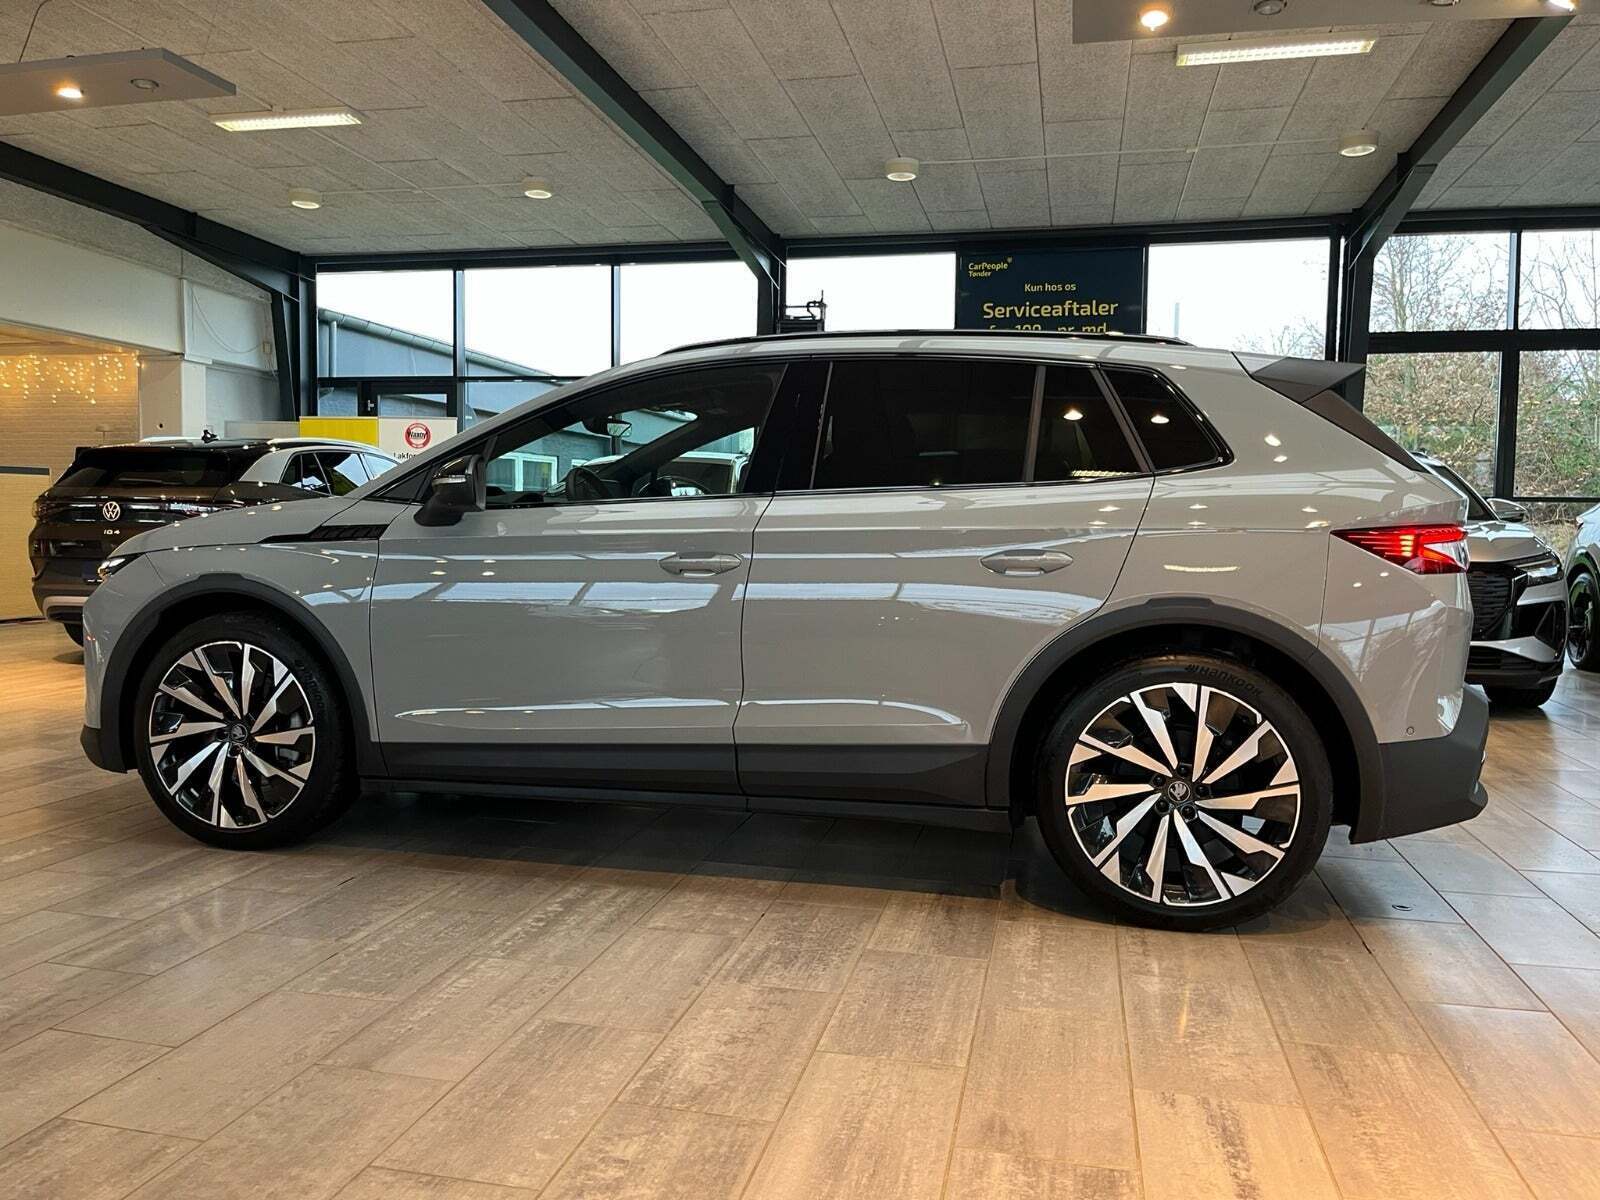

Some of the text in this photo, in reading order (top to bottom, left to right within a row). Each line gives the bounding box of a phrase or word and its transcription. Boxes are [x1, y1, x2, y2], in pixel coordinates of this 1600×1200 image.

[968, 261, 1009, 272] CarPeople
[1024, 282, 1077, 292] Kun hos os
[983, 299, 1119, 319] Serviceaftaler
